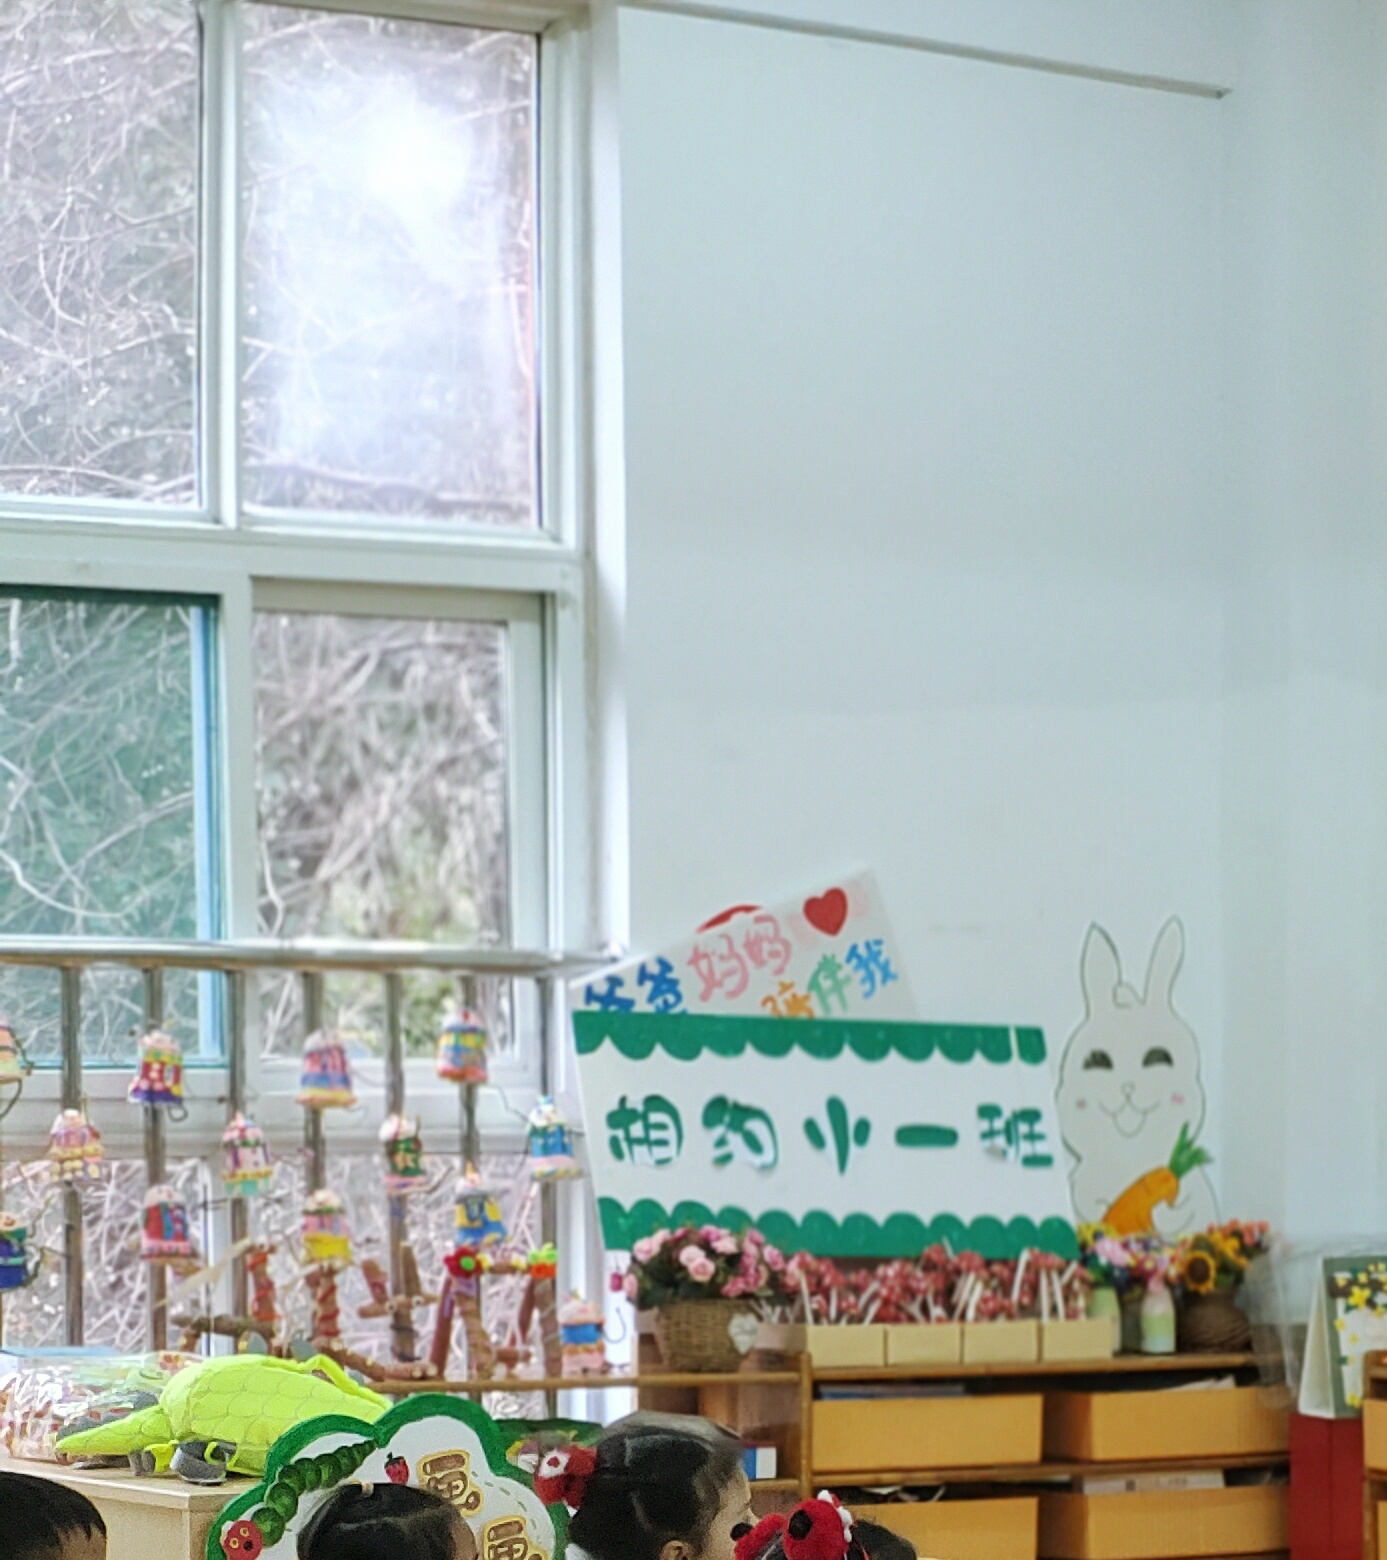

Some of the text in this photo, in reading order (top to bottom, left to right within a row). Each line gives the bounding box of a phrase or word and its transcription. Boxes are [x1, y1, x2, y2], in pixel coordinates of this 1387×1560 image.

[606, 1094, 1054, 1176] 相约小一班
